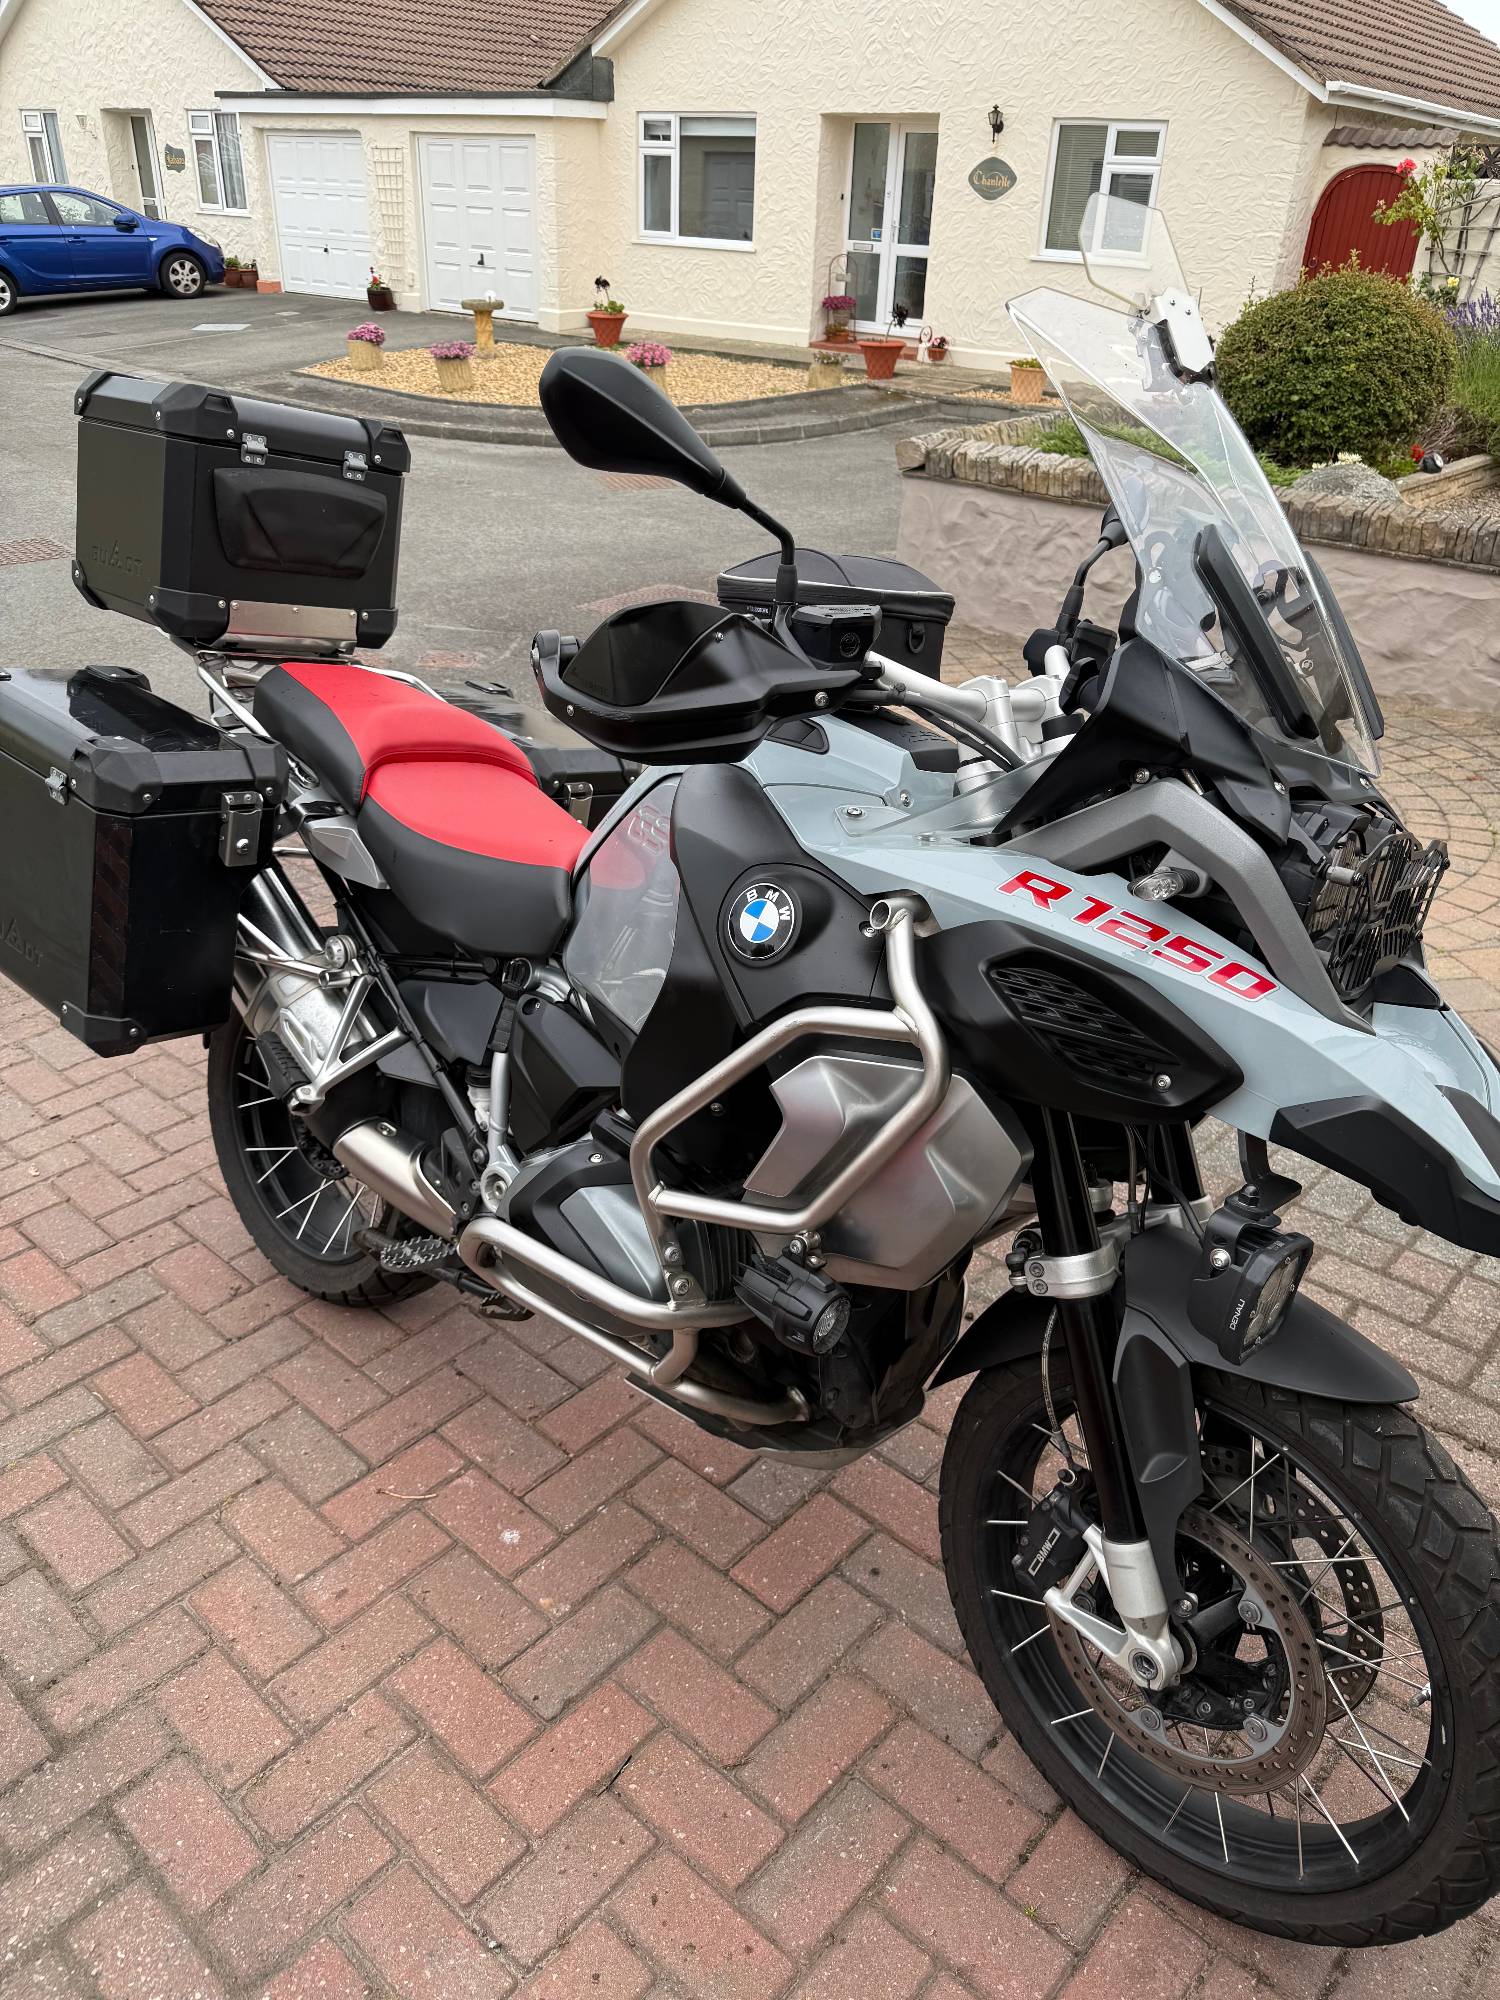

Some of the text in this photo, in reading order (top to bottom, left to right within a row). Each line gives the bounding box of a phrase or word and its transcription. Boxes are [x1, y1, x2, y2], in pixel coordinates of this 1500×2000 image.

[746, 888, 791, 921] BMW
[995, 869, 1280, 1002] R 1250
[1229, 1298, 1246, 1331] DENALI
[1036, 1539, 1053, 1563] BMW
